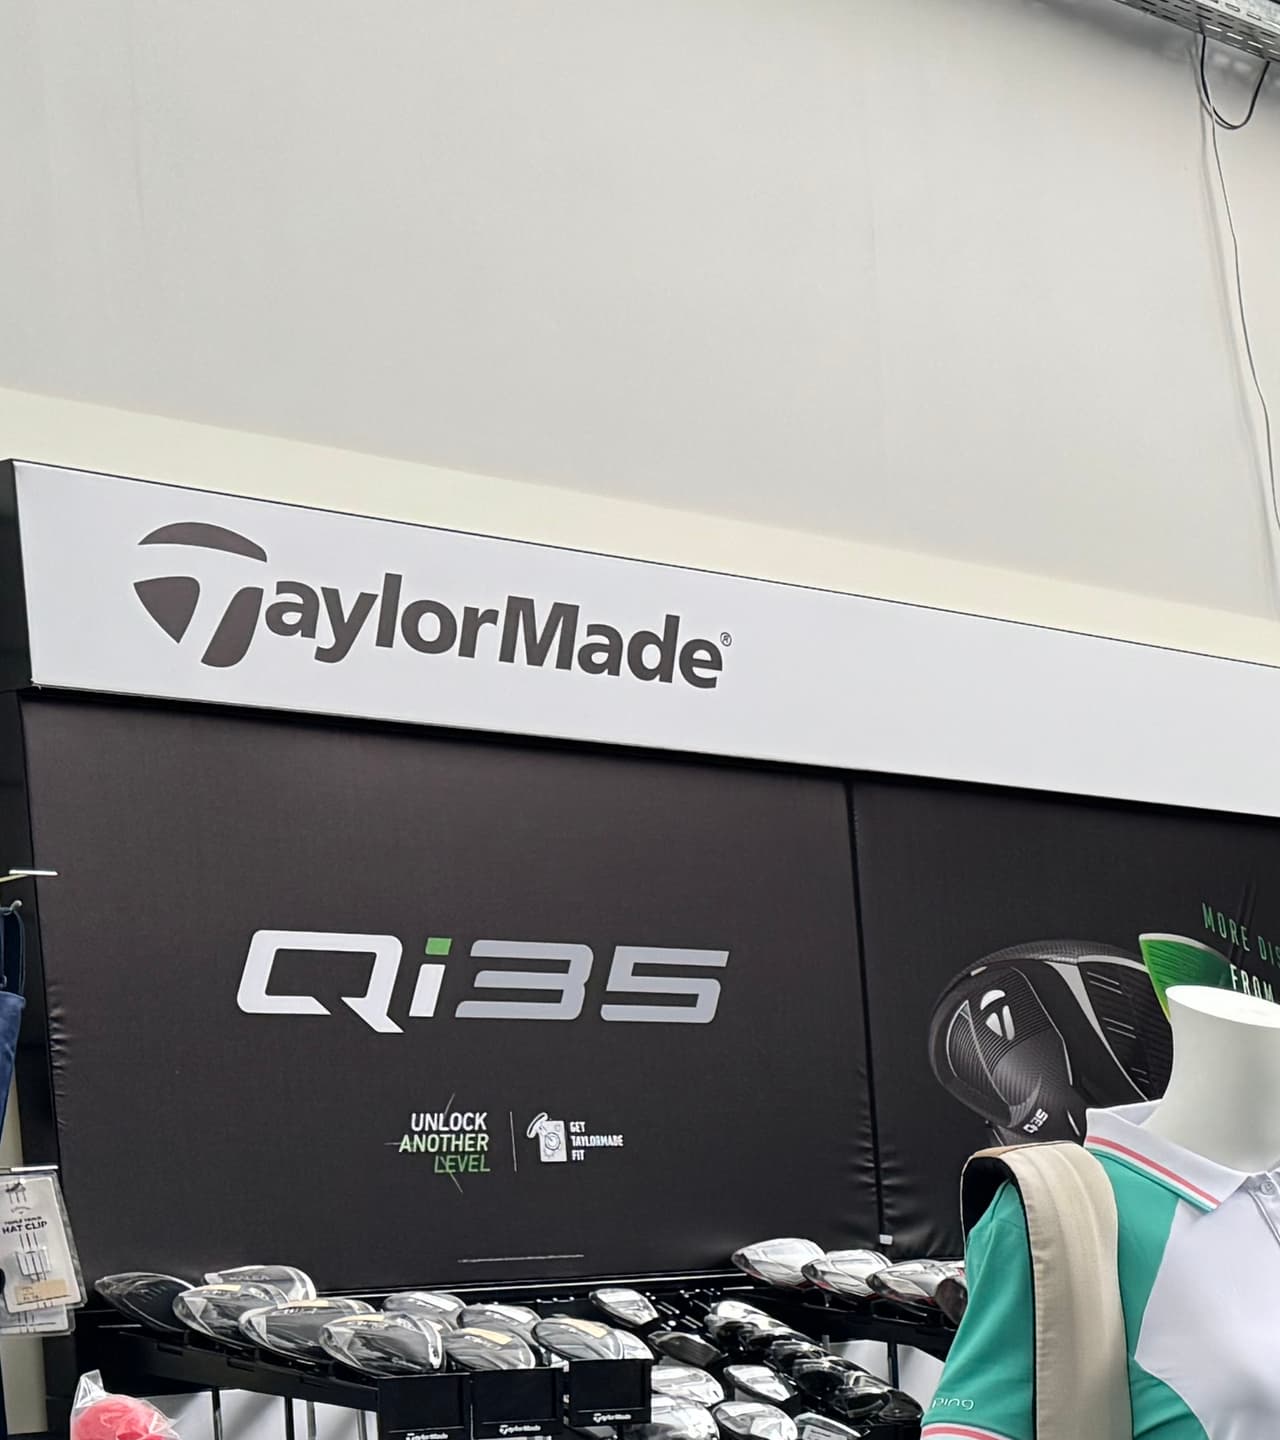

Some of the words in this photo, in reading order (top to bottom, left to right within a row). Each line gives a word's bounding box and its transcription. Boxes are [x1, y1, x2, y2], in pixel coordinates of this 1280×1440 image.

[133, 521, 724, 689] TaylorMade
[1202, 902, 1251, 951] MORE
[236, 929, 730, 1033] Qi35
[410, 1112, 488, 1132] UNLOCK
[570, 1121, 586, 1133] GET
[398, 1133, 490, 1153] ANOTHER
[571, 1134, 624, 1148] TAYLORMADE
[434, 1154, 491, 1174] LEVEL
[572, 1149, 586, 1161] FIT
[2, 1223, 22, 1235] HAT
[25, 1220, 48, 1231] CLIP
